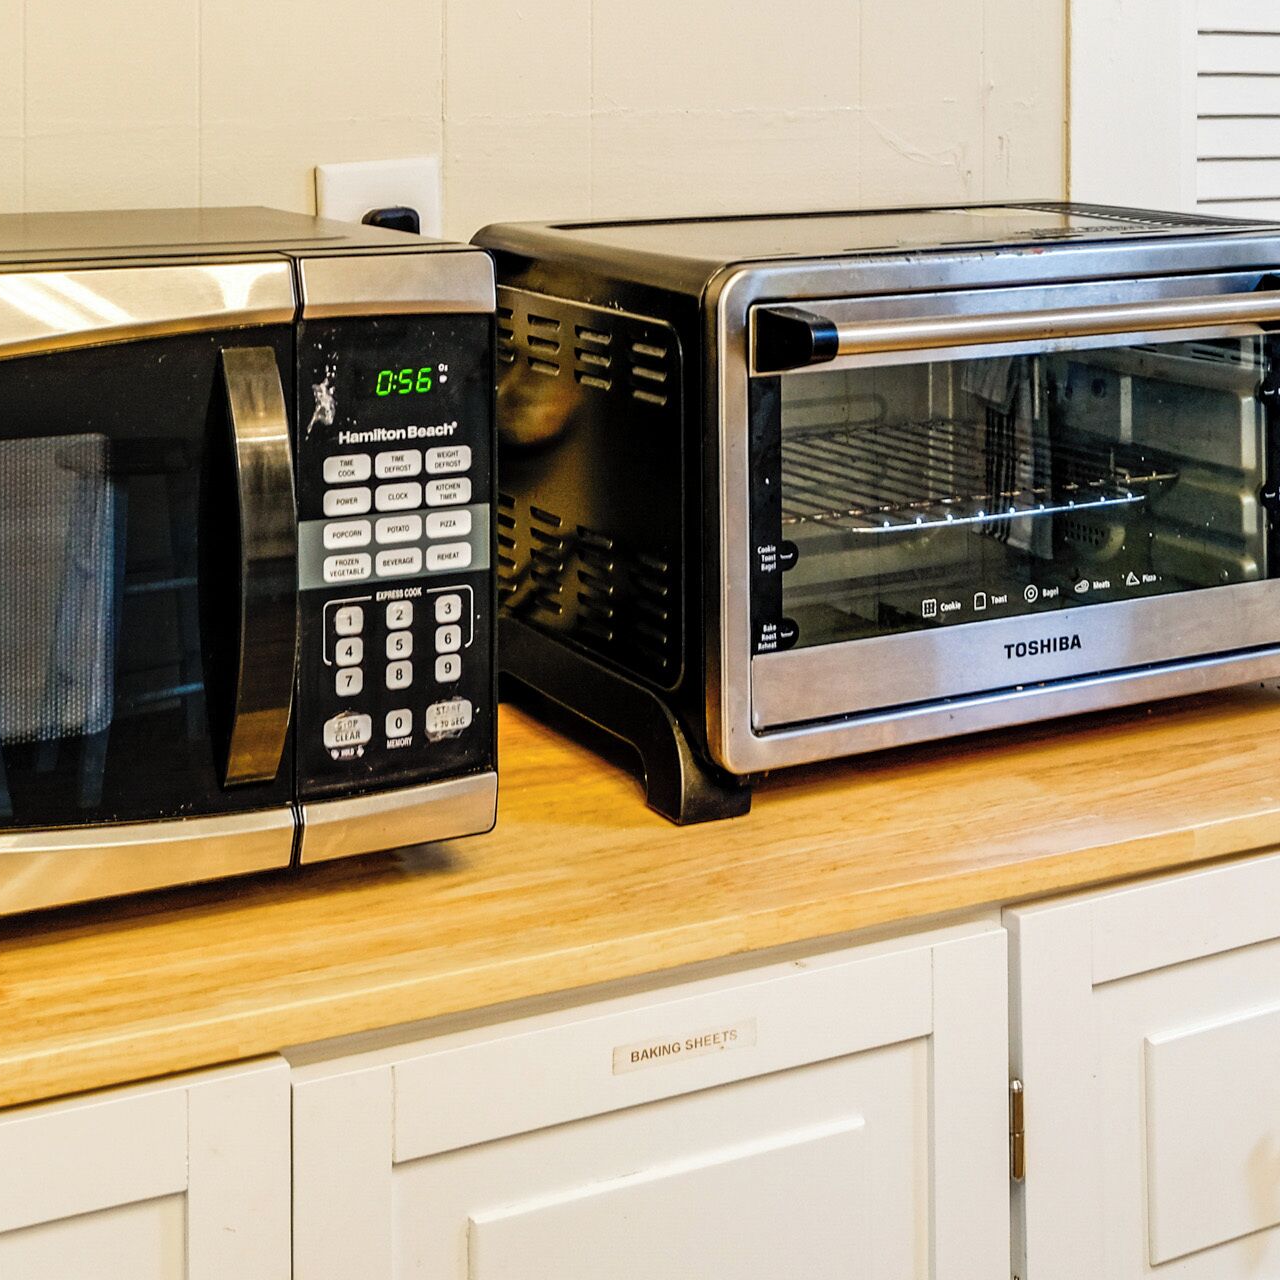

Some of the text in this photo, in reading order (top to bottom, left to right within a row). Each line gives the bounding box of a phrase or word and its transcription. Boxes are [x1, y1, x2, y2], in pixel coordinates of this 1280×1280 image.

[375, 367, 432, 396] 0:56
[338, 425, 407, 445] Hamilton
[391, 455, 405, 463] TIME
[437, 450, 459, 459] WEIGHT
[340, 459, 354, 467] TIME
[434, 459, 461, 469] DEFROST
[338, 469, 356, 477] COOK
[384, 464, 412, 474] DEFROST
[436, 482, 461, 491] KITCHEN
[336, 496, 358, 506] POWER
[388, 492, 408, 501] CLOCK
[439, 492, 458, 501] TIMER
[387, 524, 410, 534] POTATO
[439, 520, 457, 528] PIZZA
[332, 529, 362, 539] POPCORN
[757, 545, 776, 554] Cookie
[382, 556, 414, 567] BEVERAGE
[437, 551, 459, 561] REHEAT
[761, 554, 776, 562] Toast
[335, 557, 360, 567] FROZEN
[761, 562, 776, 573] Bagel
[329, 567, 365, 578] VEGETABLE
[376, 587, 422, 602] EXPRESS COOK
[1042, 586, 1059, 598] Bagel
[991, 593, 1008, 605] Toast
[444, 603, 452, 614] 3
[940, 600, 961, 613] Cookie
[395, 609, 403, 620] 2
[346, 616, 352, 627] 1
[763, 624, 777, 632] Bake
[444, 633, 452, 645] 6
[395, 639, 403, 651] 5
[1004, 634, 1082, 659] TOSHIBA
[345, 645, 353, 657] 4
[444, 662, 452, 674] 9
[395, 669, 403, 680] 8
[345, 675, 353, 688] 7
[436, 703, 461, 716] STT
[395, 717, 403, 729] 0
[335, 730, 360, 742] CLEAR
[386, 737, 413, 749] MEMORY
[631, 1029, 738, 1063] BAKING SHEETS
